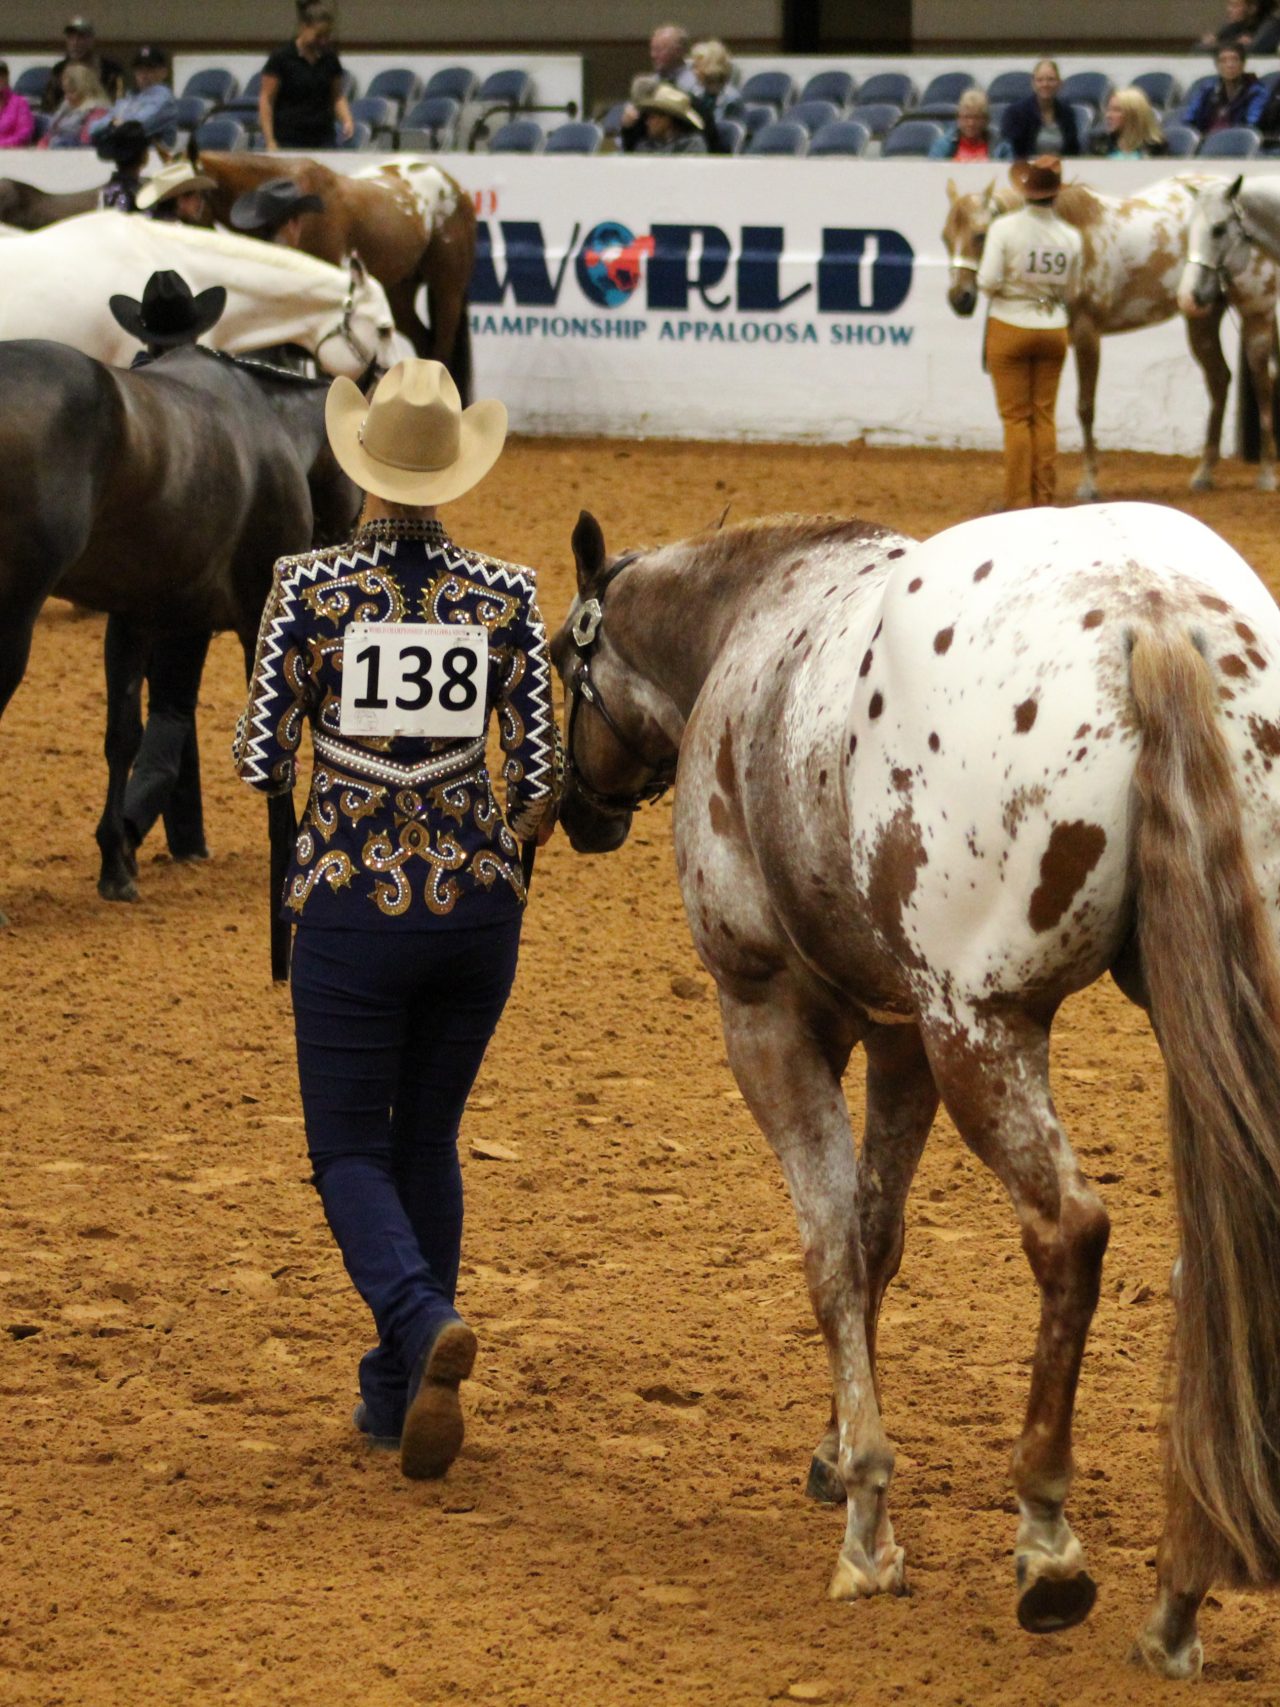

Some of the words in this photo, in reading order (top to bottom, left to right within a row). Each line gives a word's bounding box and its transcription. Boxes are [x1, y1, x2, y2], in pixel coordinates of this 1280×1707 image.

[467, 220, 914, 314] WORLD
[1026, 251, 1067, 276] 159
[470, 314, 647, 339] HAMPIONSHIP
[659, 320, 818, 343] APPALOOSA
[830, 323, 914, 346] SHOW
[354, 645, 478, 711] 138
